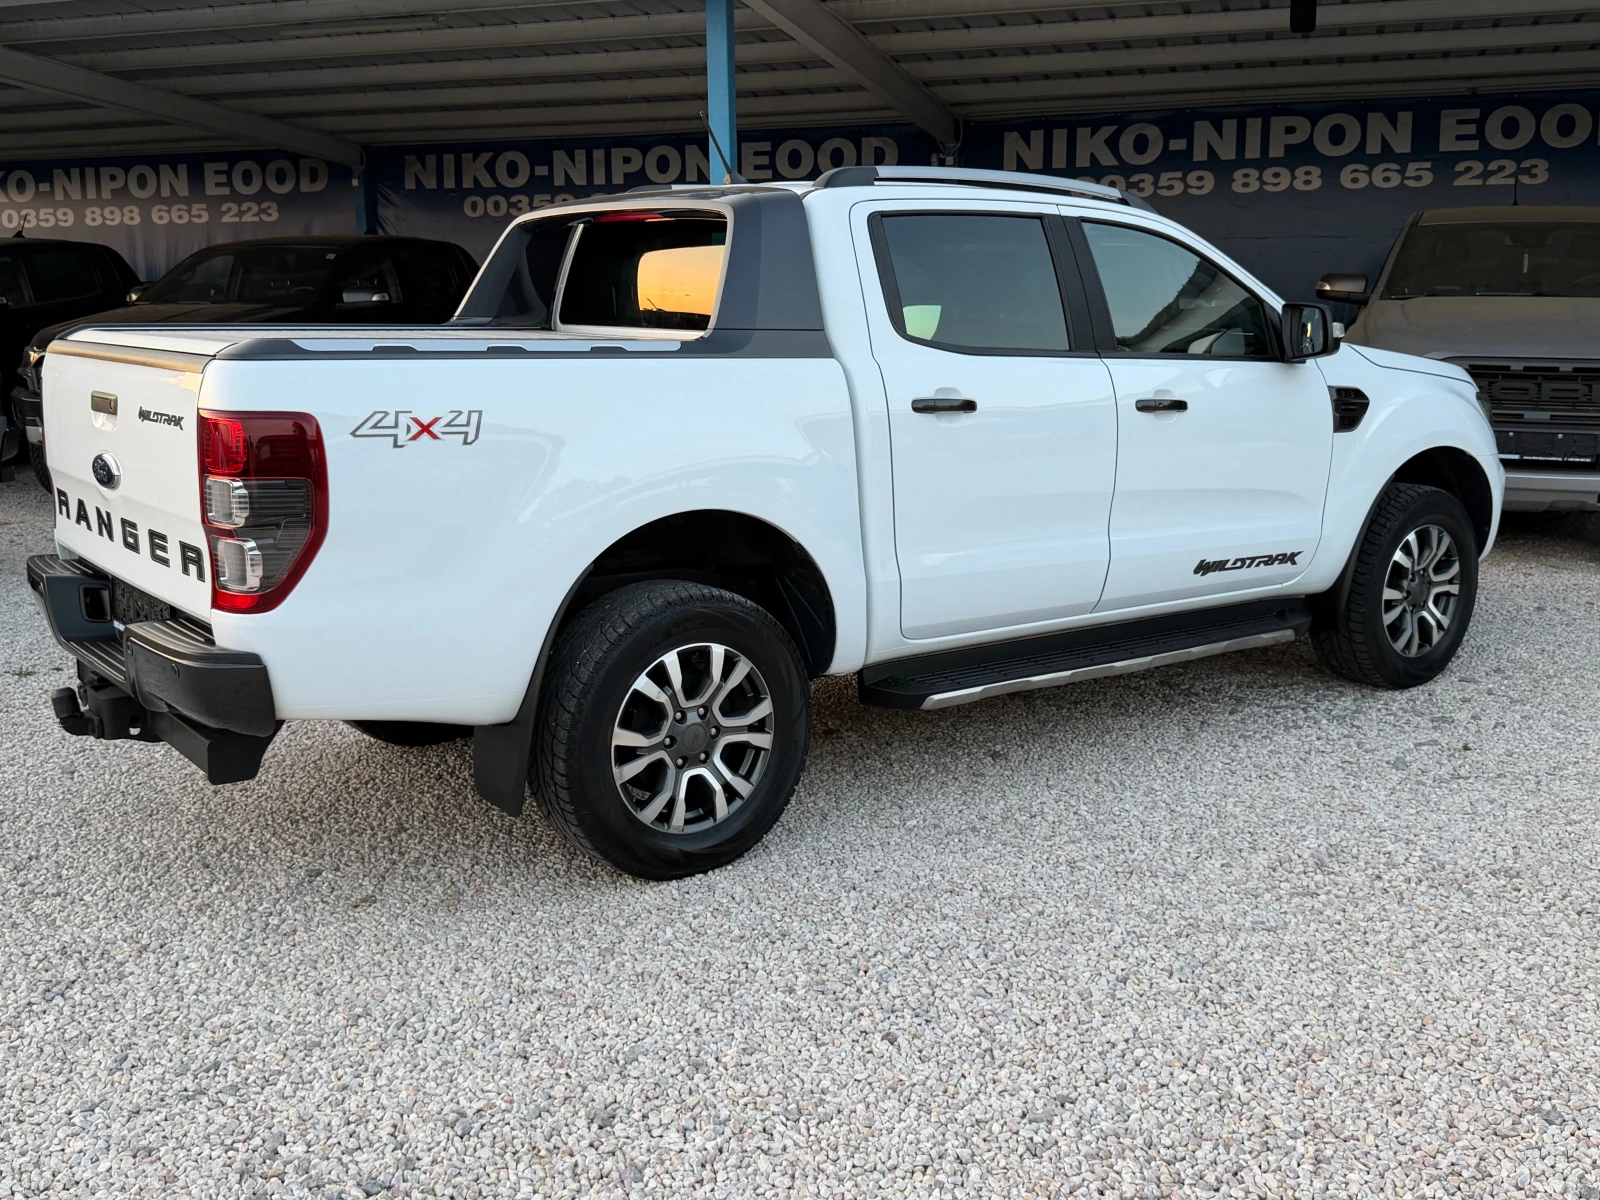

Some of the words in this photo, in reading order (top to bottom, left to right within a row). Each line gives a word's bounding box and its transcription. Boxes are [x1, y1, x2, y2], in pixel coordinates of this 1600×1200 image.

[1003, 111, 1413, 171] NIKO-NIPON
[1438, 103, 1600, 152] EOO
[740, 136, 899, 180] EOOD
[1231, 164, 1323, 193] 898
[1339, 160, 1434, 190] 665
[1452, 158, 1550, 187] 223
[203, 158, 329, 196] EOOD
[84, 205, 141, 227] 898
[151, 203, 209, 225] 665
[220, 201, 280, 224] 223
[138, 406, 185, 431] WILDTRAK
[56, 487, 206, 583] RANGER
[1193, 551, 1304, 577] WILDTRAK
